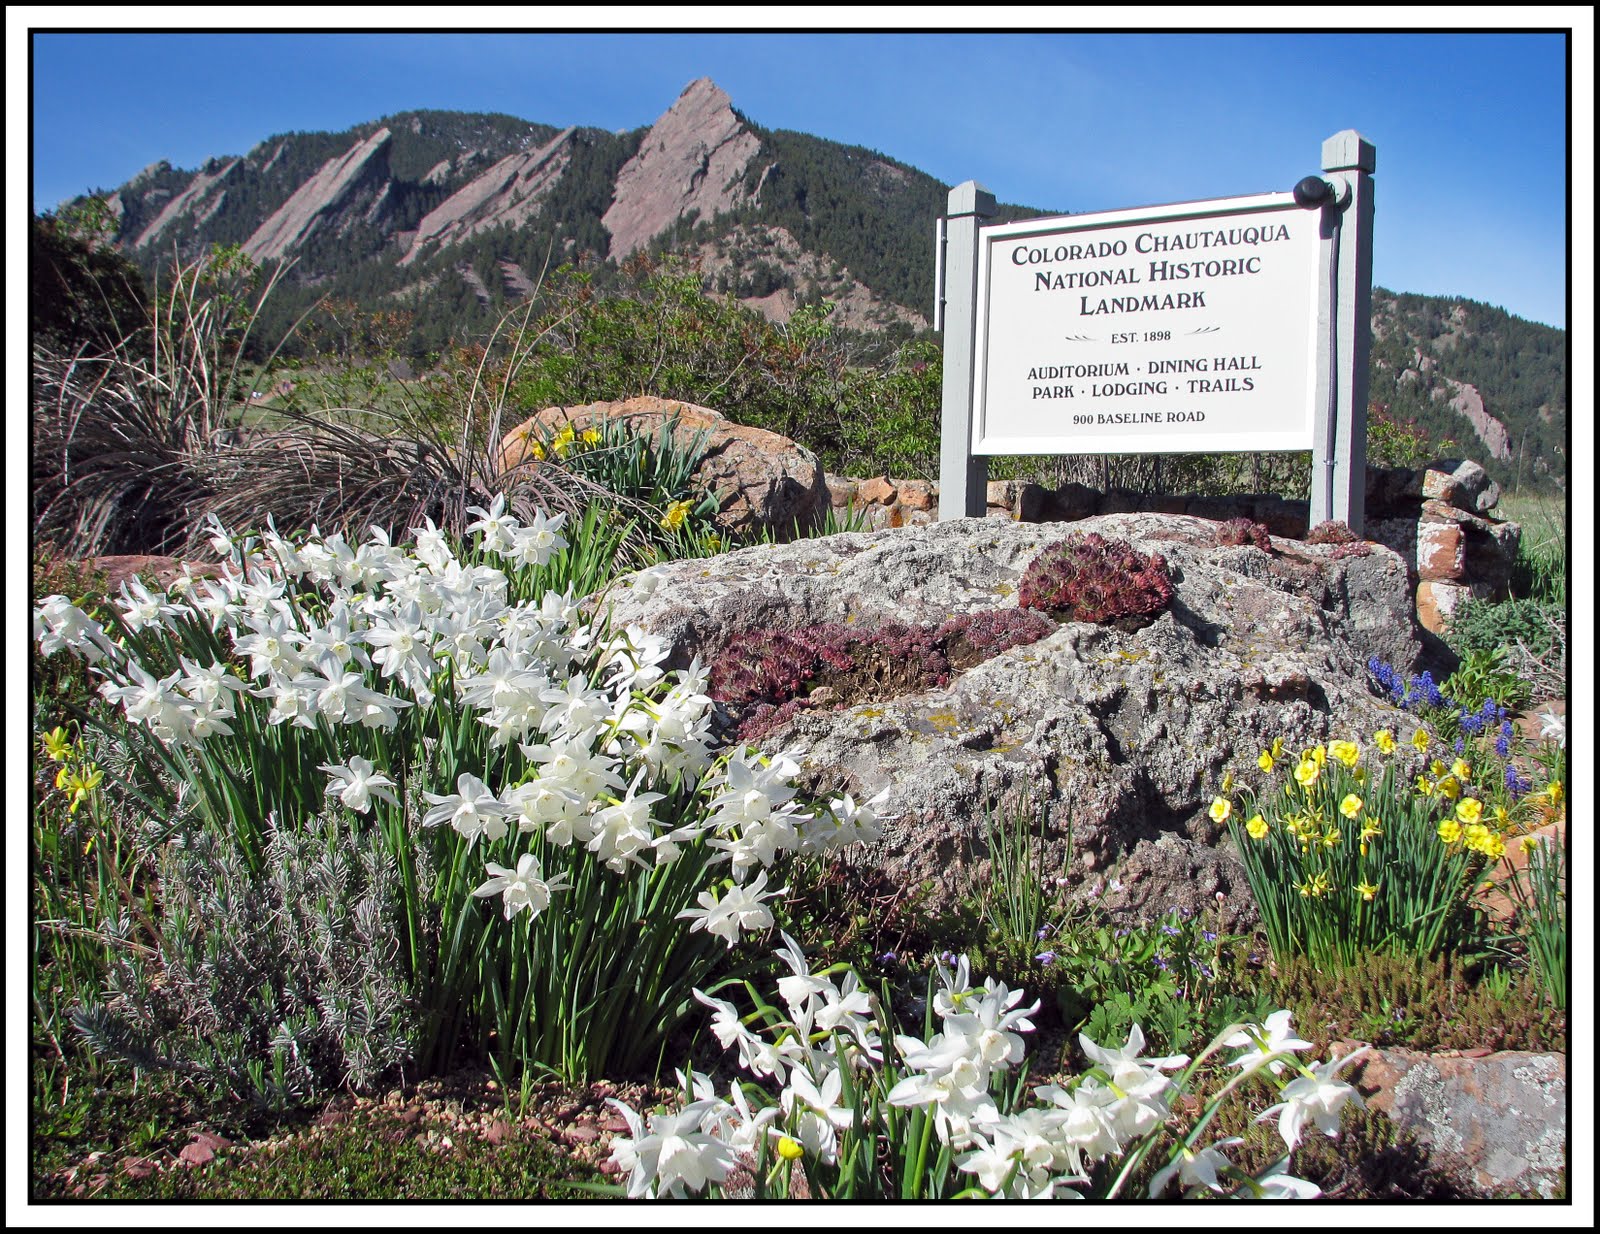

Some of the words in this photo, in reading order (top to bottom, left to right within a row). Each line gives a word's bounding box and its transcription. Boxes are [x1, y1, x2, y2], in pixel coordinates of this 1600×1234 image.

[1011, 240, 1128, 265] COLORADO
[1134, 224, 1290, 254] CHAUTAUQUA
[1034, 268, 1141, 291] NATIONAL
[1148, 256, 1261, 282] HISTORIC
[1079, 291, 1206, 316] LANDMARK
[1111, 332, 1138, 344] EST.
[1143, 330, 1171, 342] 1898
[1027, 362, 1130, 380] AUDITORIUM
[1148, 358, 1208, 374] DINING
[1213, 356, 1262, 371] HALL
[1032, 385, 1075, 400] PARK
[1092, 381, 1168, 397] LODGING
[1187, 377, 1255, 393] TRAILS
[1073, 414, 1094, 425] 900
[1097, 412, 1163, 424] BASELINE
[1166, 411, 1206, 423] ROAD
